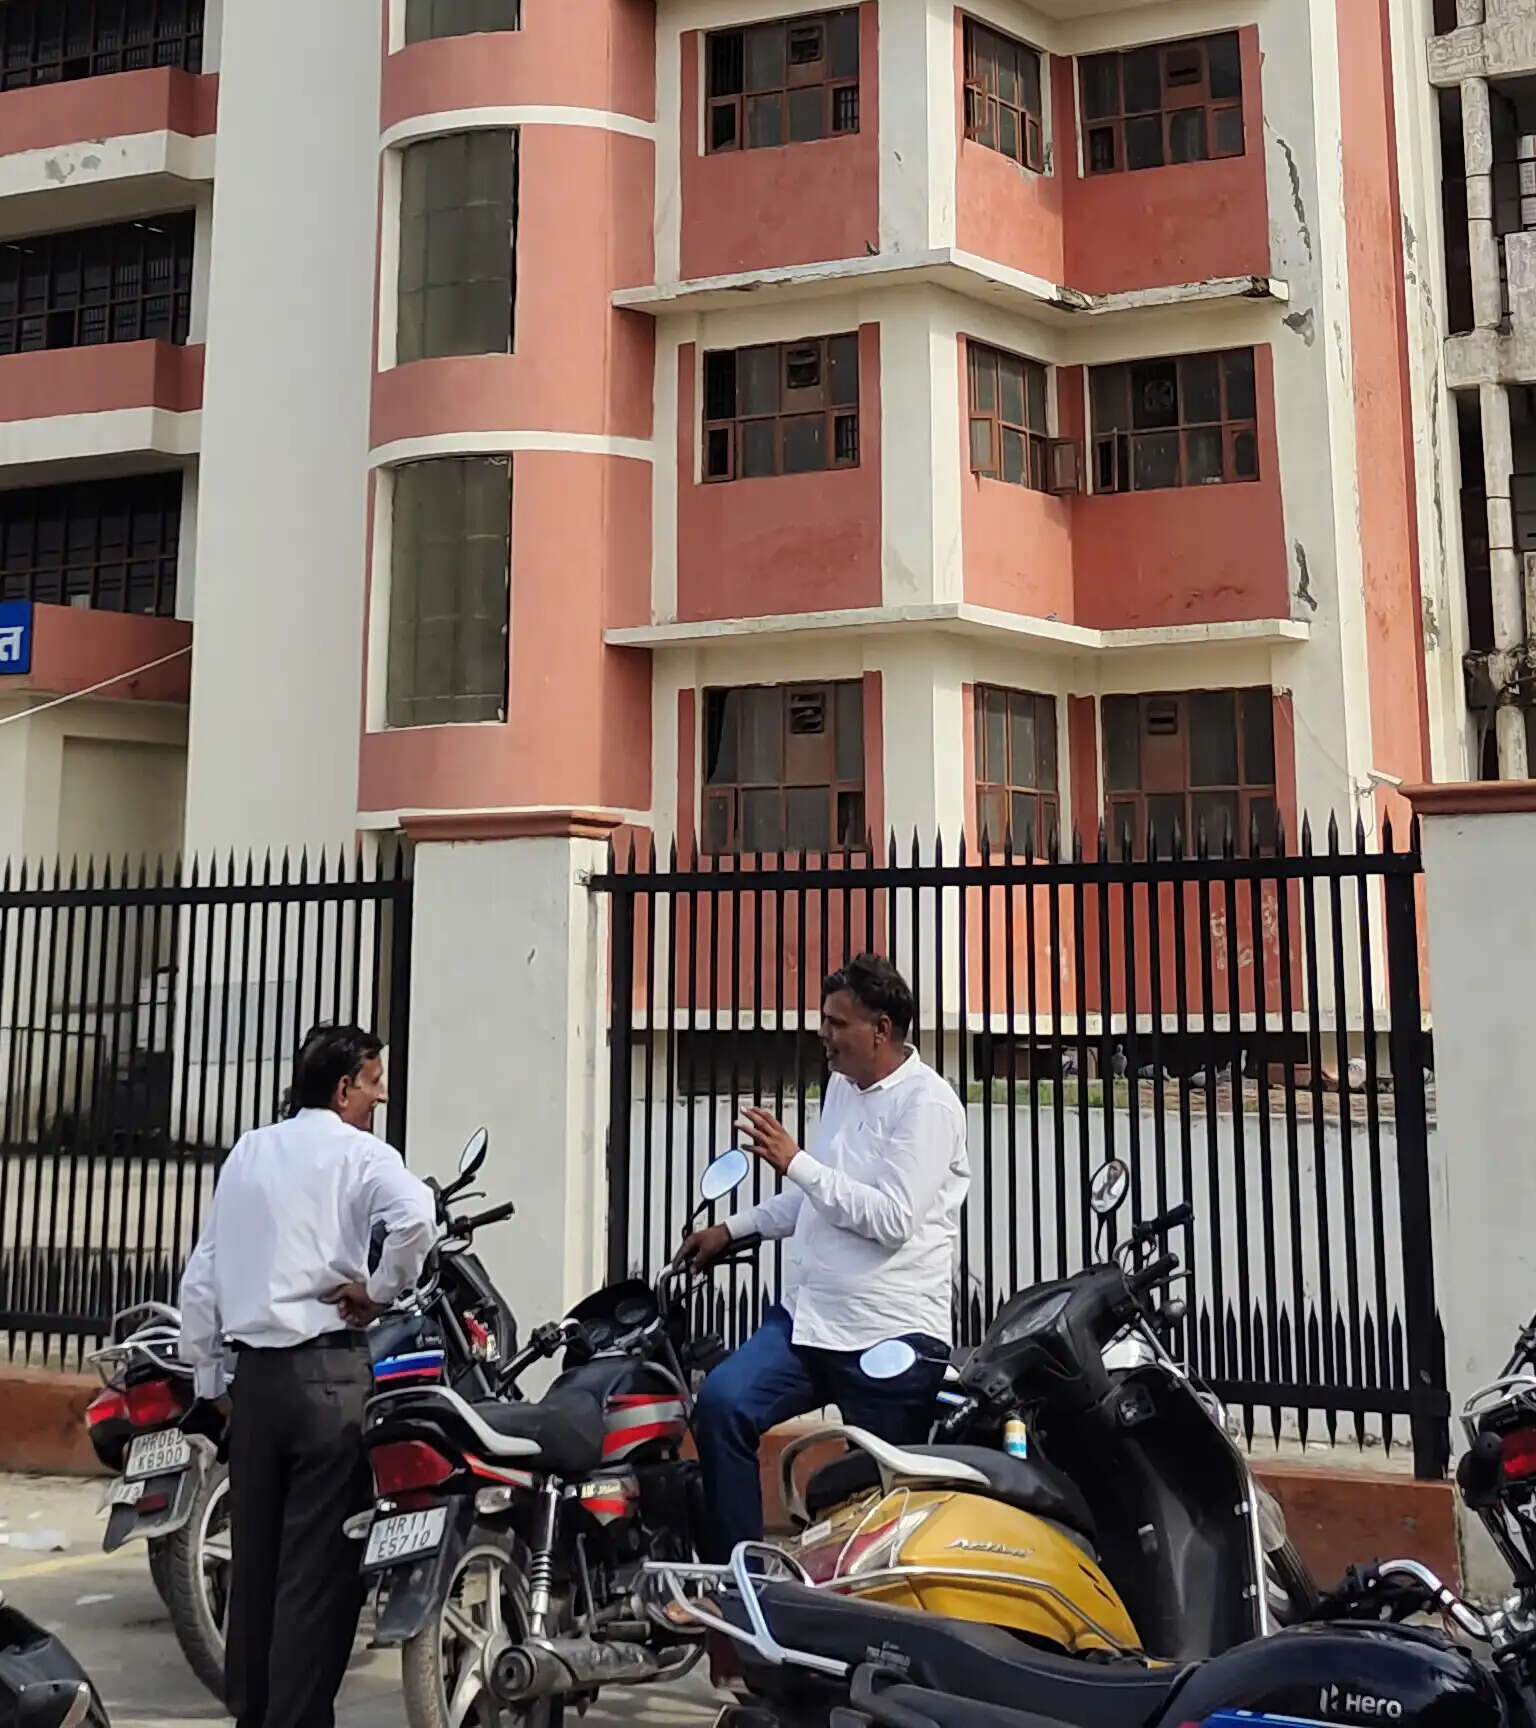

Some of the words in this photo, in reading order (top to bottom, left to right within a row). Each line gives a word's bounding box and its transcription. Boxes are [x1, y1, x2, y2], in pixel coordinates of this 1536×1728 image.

[385, 1511, 429, 1538] HR11
[377, 1529, 431, 1559] E5710
[1345, 1692, 1402, 1719] Hero
